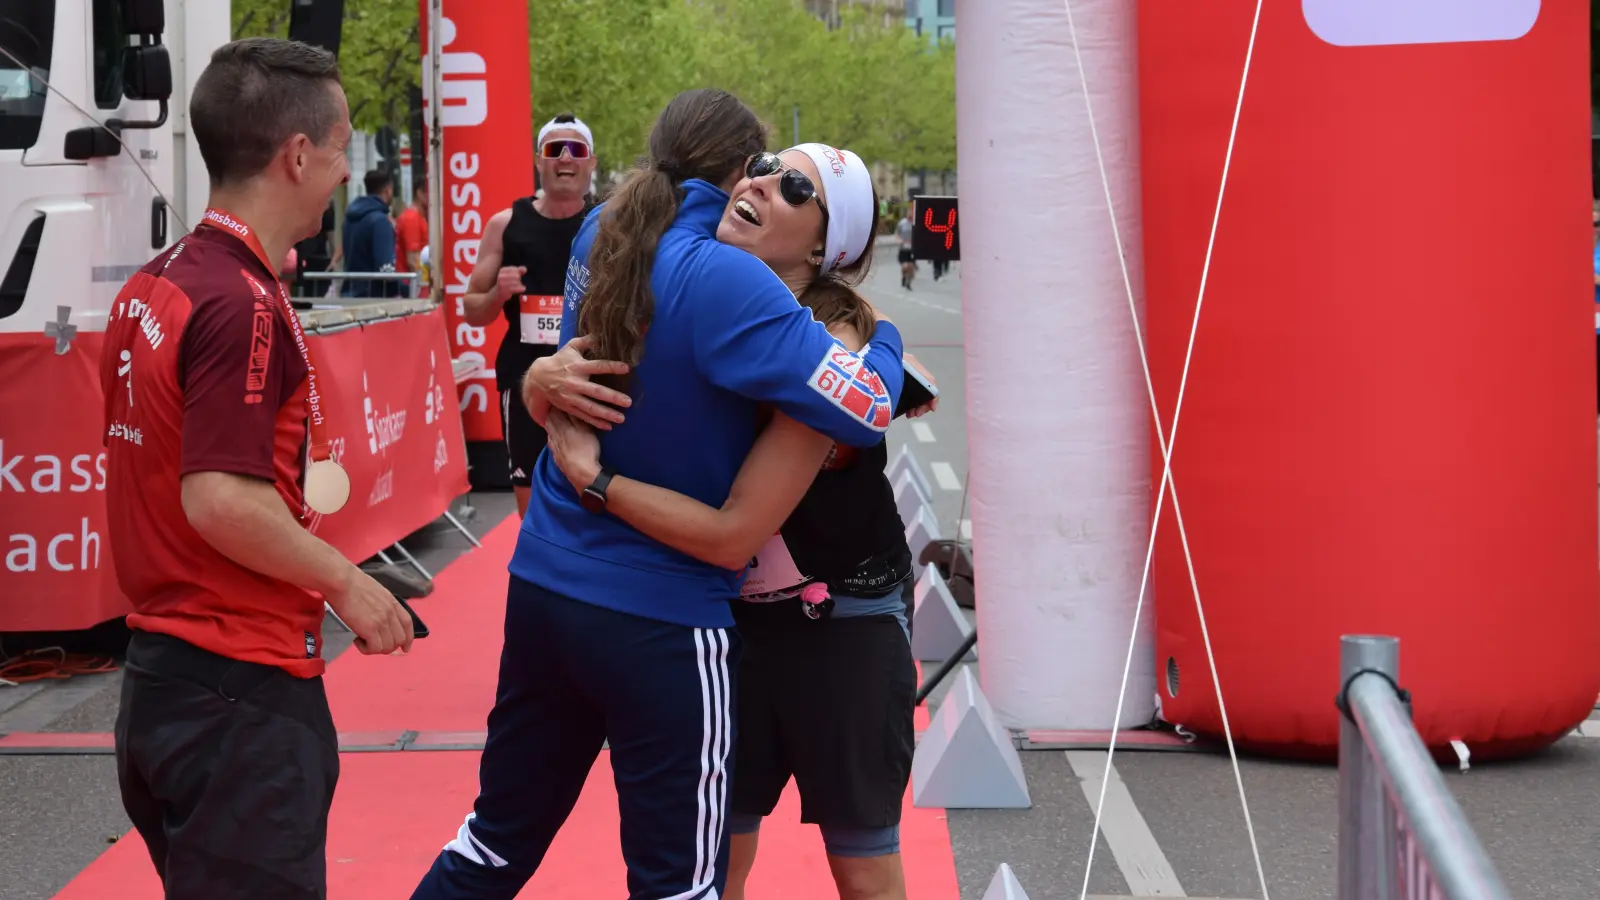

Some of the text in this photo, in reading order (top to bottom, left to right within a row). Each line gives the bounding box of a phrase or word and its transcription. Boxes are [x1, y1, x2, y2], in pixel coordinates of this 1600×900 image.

[924, 207, 957, 251] 4
[307, 373, 325, 426] Ansbach
[817, 369, 846, 399] 19
[5, 516, 101, 573] ach
